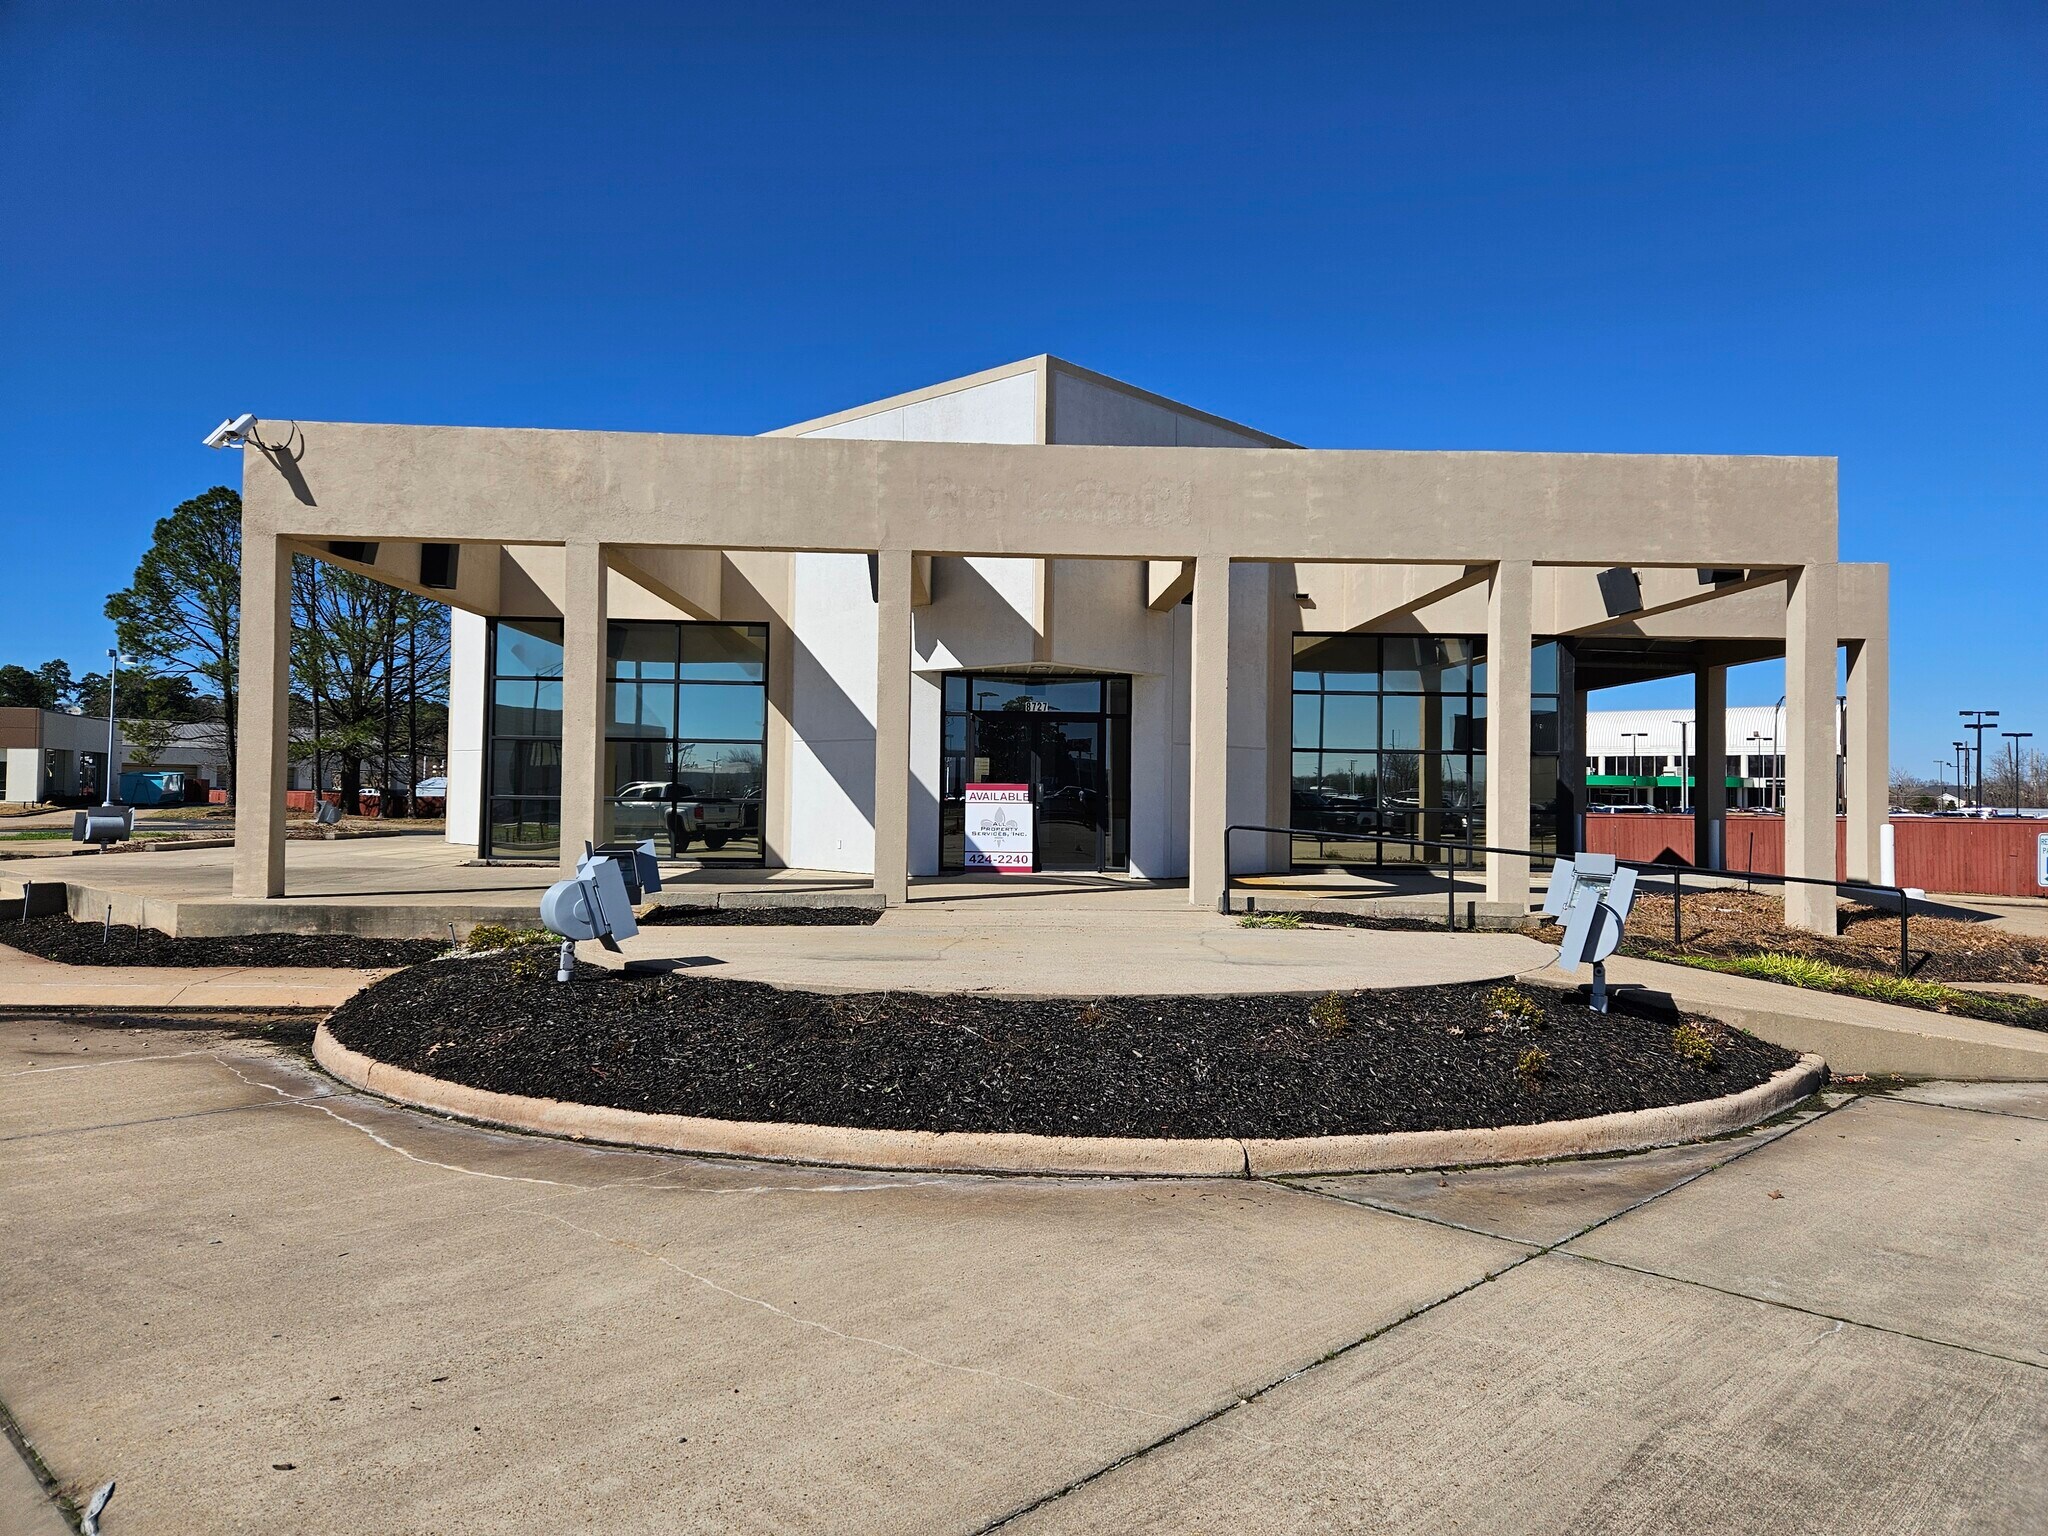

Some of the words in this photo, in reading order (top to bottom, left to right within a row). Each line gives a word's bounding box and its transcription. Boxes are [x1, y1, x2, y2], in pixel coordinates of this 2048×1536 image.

[1026, 702, 1048, 711] 8727
[969, 792, 1028, 801] AVAILABLE
[969, 854, 1028, 864] 424-2240
